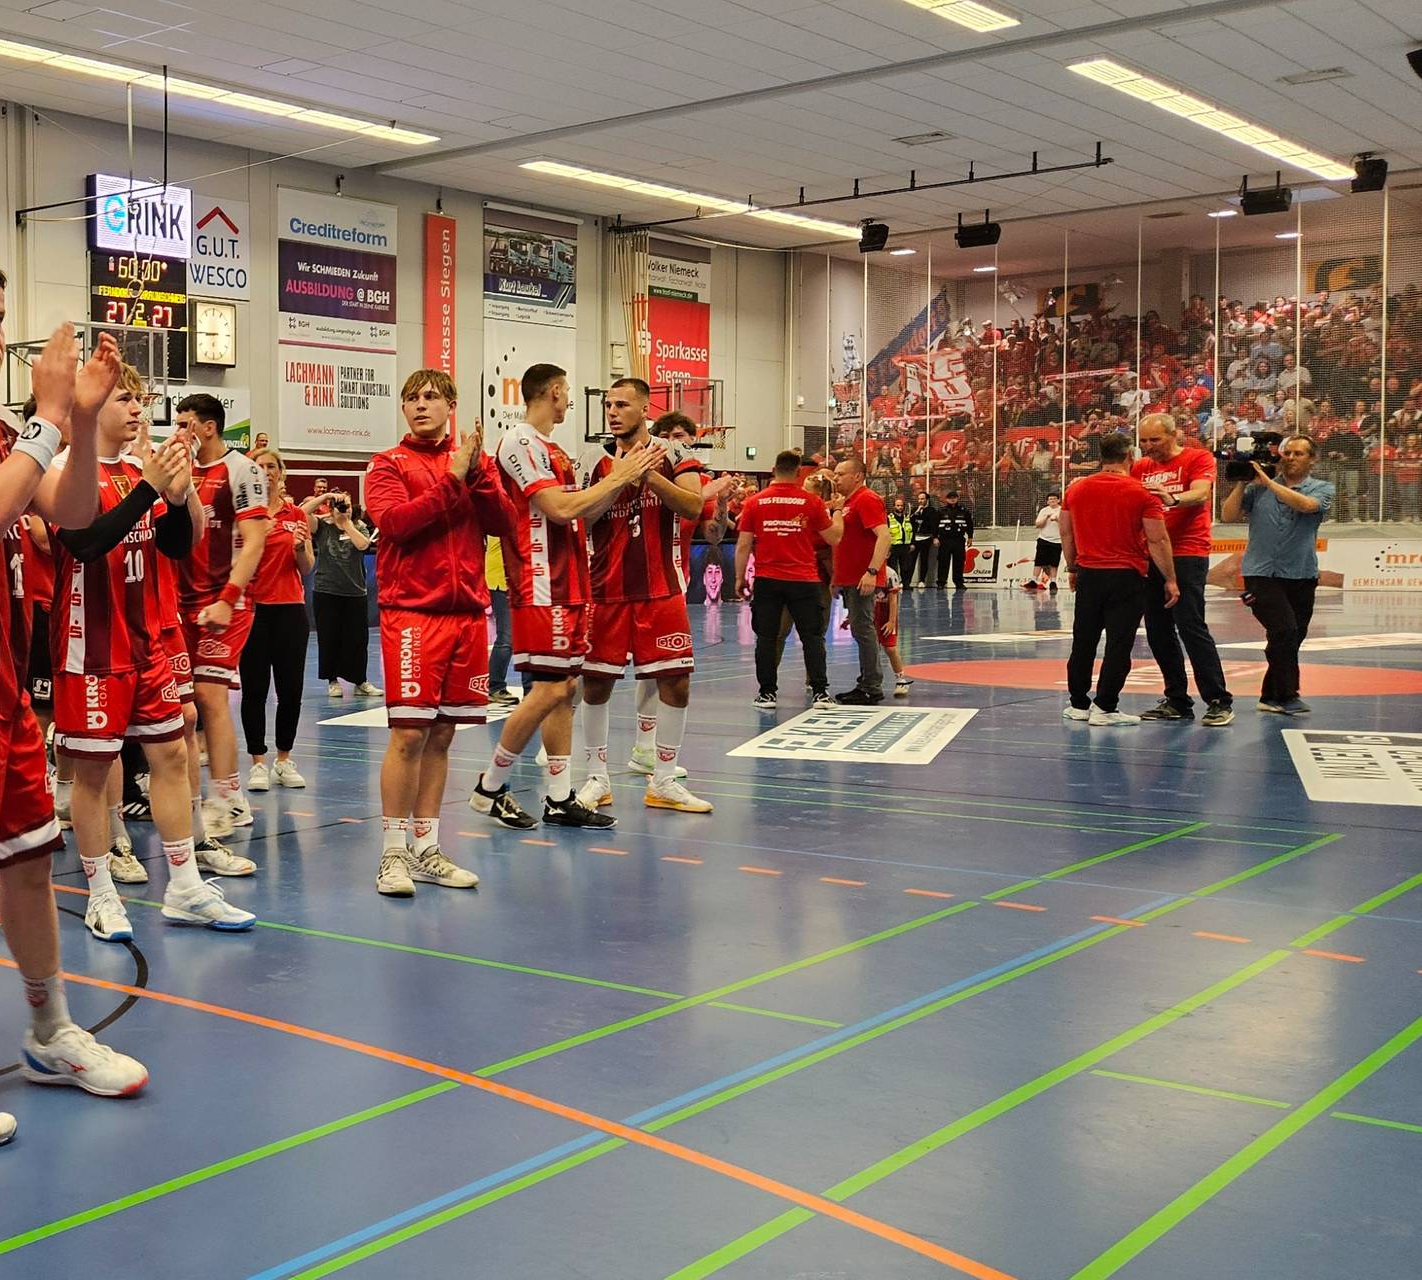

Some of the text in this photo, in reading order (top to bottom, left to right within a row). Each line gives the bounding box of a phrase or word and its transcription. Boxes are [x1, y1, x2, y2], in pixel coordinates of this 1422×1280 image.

[290, 217, 387, 247] Creditreform
[196, 235, 241, 259] G.U.T.
[189, 262, 248, 289] WESCO
[297, 261, 311, 272] Wir
[312, 264, 351, 278] SCHMIEDEN
[438, 229, 453, 298] Siegen
[285, 279, 390, 305] AUSBILDUNG @ BGH
[152, 305, 172, 327] 27
[656, 339, 707, 362] Sparkasse
[285, 361, 375, 386] LACHMANN PARTNER FOR
[312, 386, 335, 408] RINK
[340, 380, 391, 397] SMART INDUSTRIAL
[340, 395, 369, 410] SOLUTIONS
[124, 549, 144, 583] 10
[413, 626, 422, 679] COATINGS
